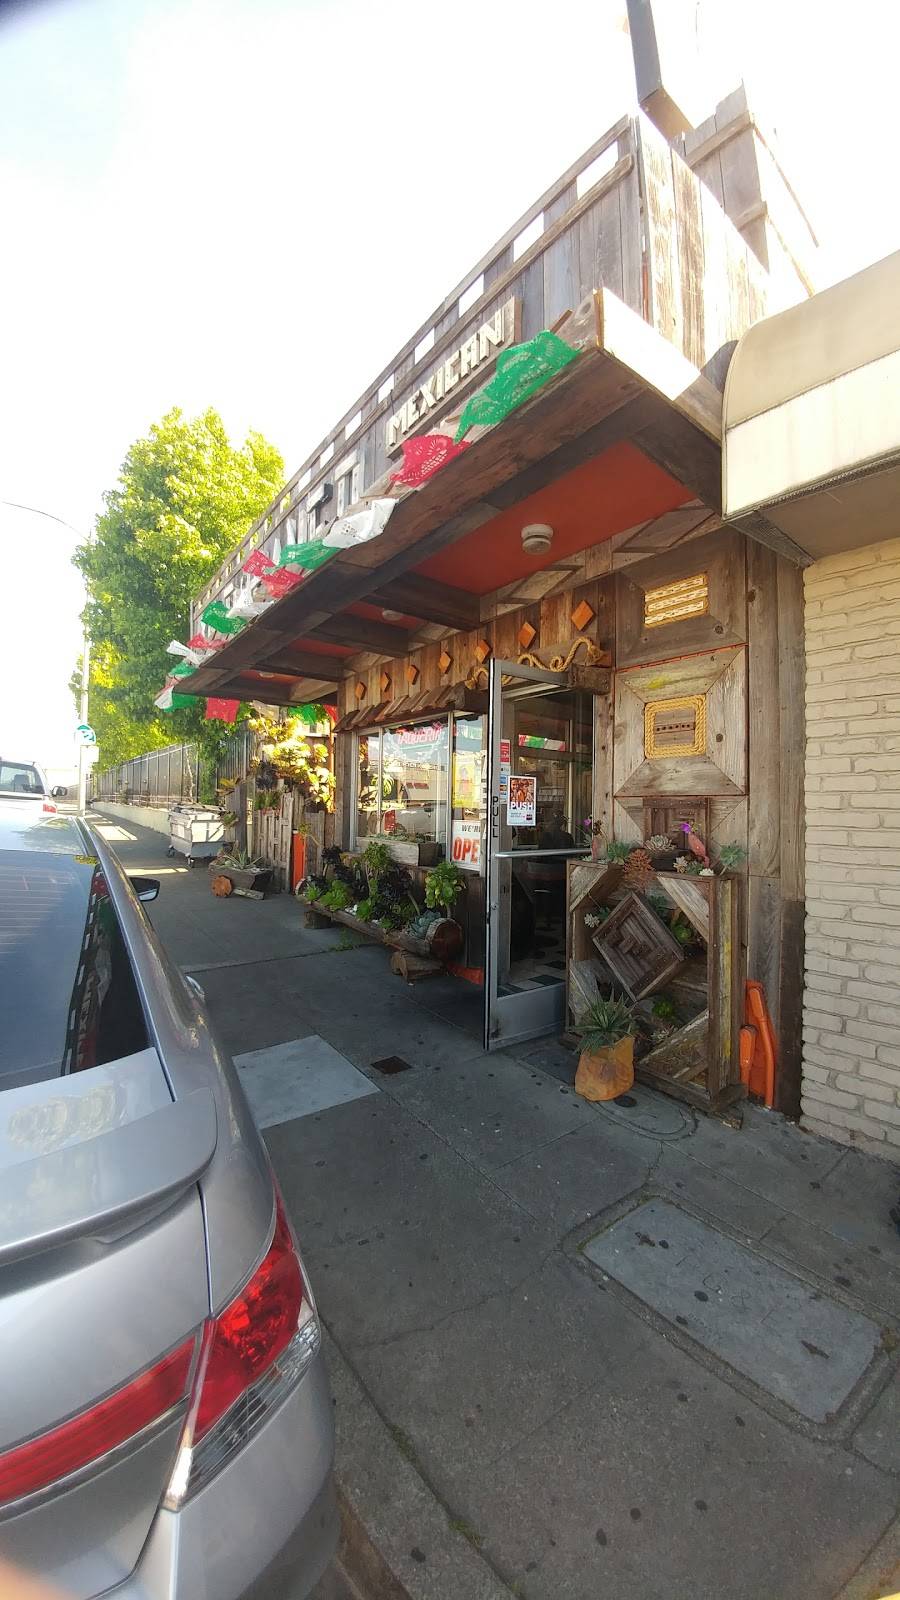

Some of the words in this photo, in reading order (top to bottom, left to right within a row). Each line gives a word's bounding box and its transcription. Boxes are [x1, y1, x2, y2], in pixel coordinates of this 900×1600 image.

[386, 307, 505, 447] MEXICAN
[510, 802, 533, 810] PUSH
[453, 838, 480, 864] OPE
